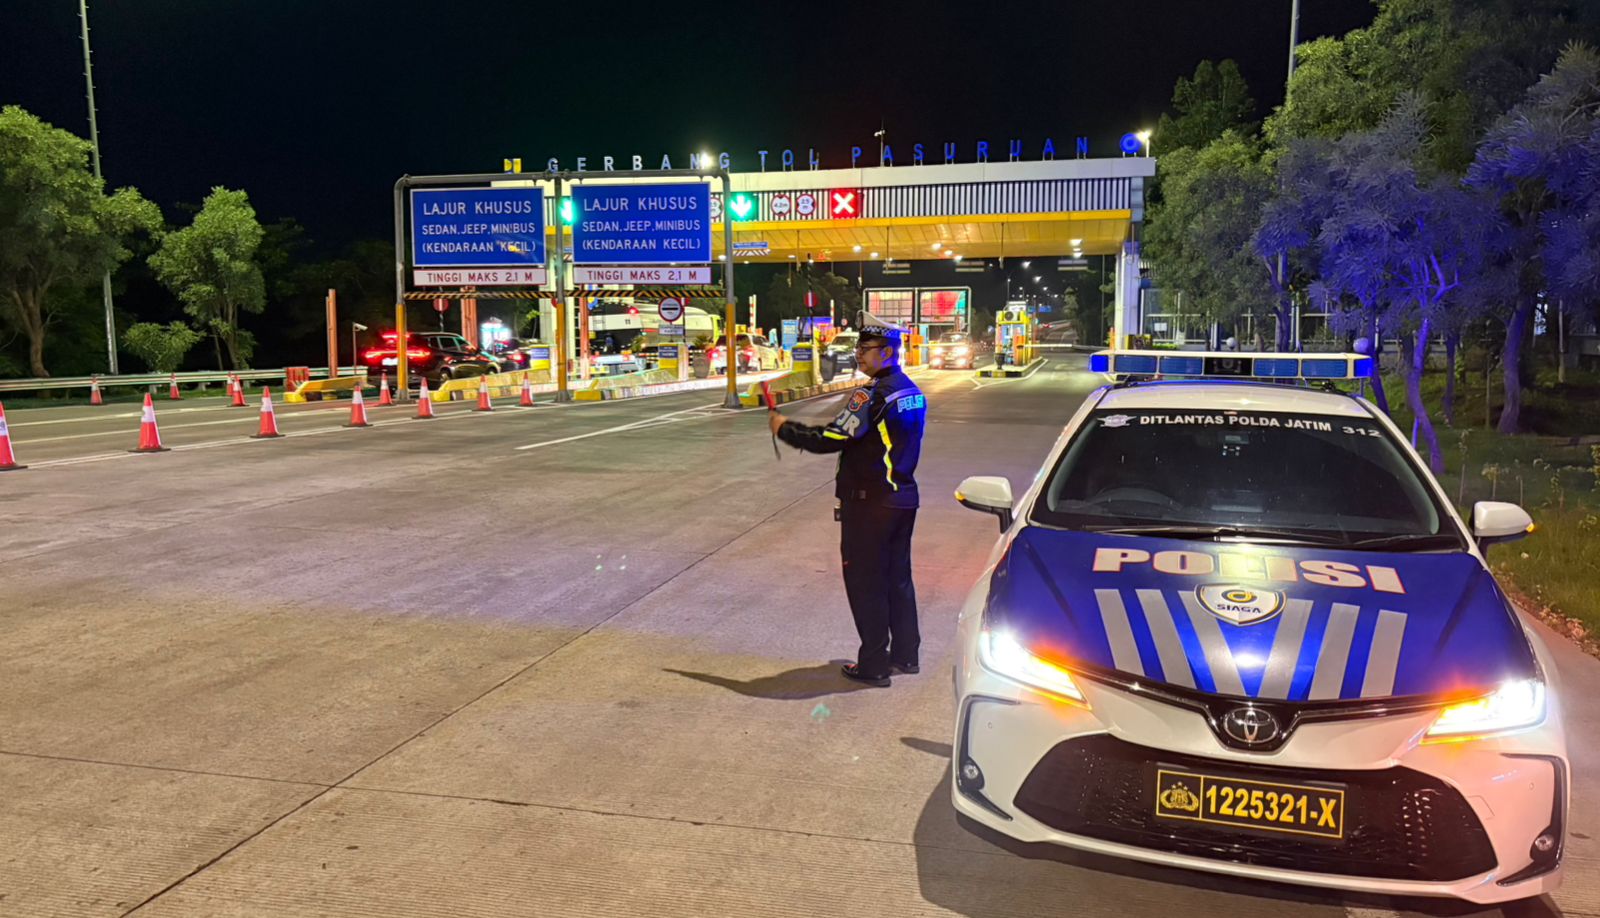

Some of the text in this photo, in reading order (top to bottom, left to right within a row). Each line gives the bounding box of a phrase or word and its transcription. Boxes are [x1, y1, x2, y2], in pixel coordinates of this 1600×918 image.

[548, 136, 1088, 173] GERBANG TOL PASURUAN
[423, 200, 532, 215] LAJUR KHUSUS
[583, 198, 629, 211] LAJUR
[638, 196, 697, 210] KHUSUS
[422, 242, 494, 253] (KENDARAAN
[582, 238, 701, 250] (KENDARAAN KECIL)
[427, 273, 462, 283] TINGGI
[468, 272, 498, 282] MAKS
[525, 272, 533, 281] M
[587, 270, 623, 280] TINGGI
[630, 270, 661, 280] MAKS
[689, 270, 697, 280] M
[1140, 415, 1382, 438] DITLANTAS POLDA JATIM 312
[1092, 547, 1407, 594] POLISI
[1216, 604, 1261, 614] SIAGA
[1206, 785, 1337, 828] 1225321-X
